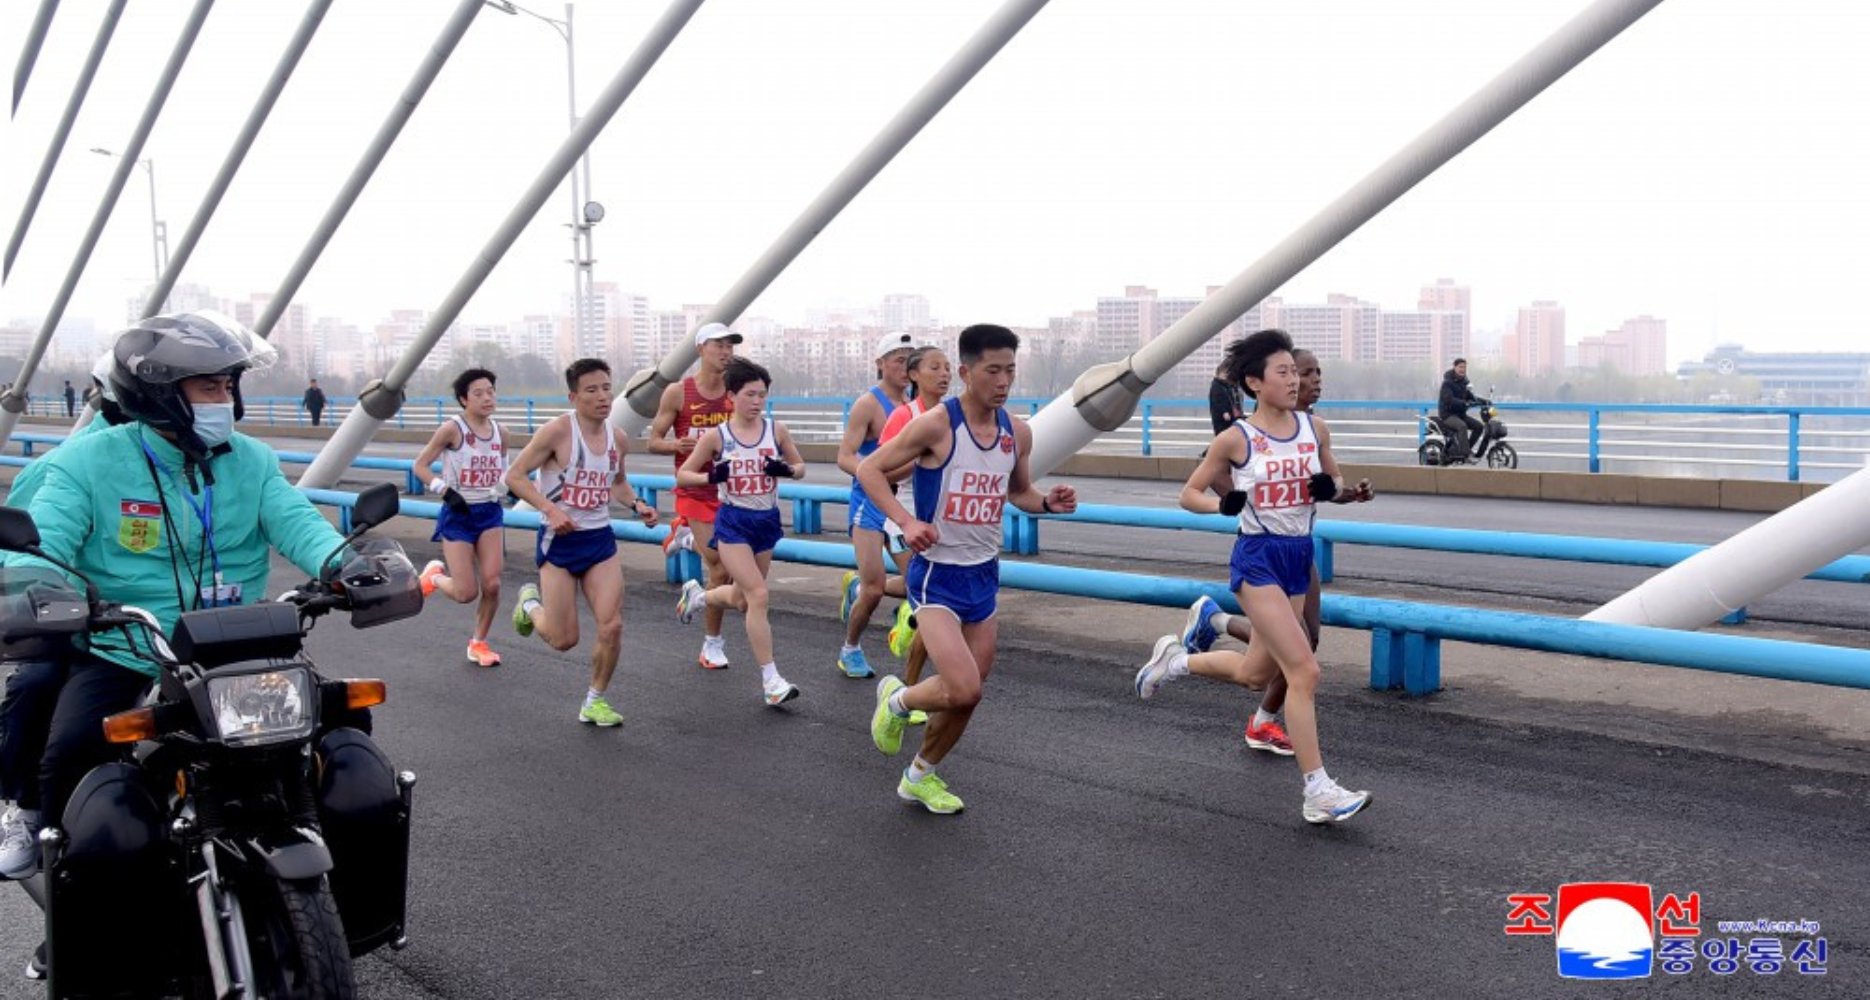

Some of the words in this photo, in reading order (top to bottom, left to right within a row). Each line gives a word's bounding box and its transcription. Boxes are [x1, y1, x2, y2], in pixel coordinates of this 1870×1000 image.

[470, 455, 498, 468] PRK
[1266, 456, 1313, 480] PRK
[461, 470, 500, 487] 1203
[575, 470, 610, 487] PRK
[728, 476, 773, 494] 1219
[961, 472, 1004, 493] PRK
[564, 484, 609, 508] 1059
[1259, 480, 1313, 507] 121
[947, 496, 1001, 522] 1062
